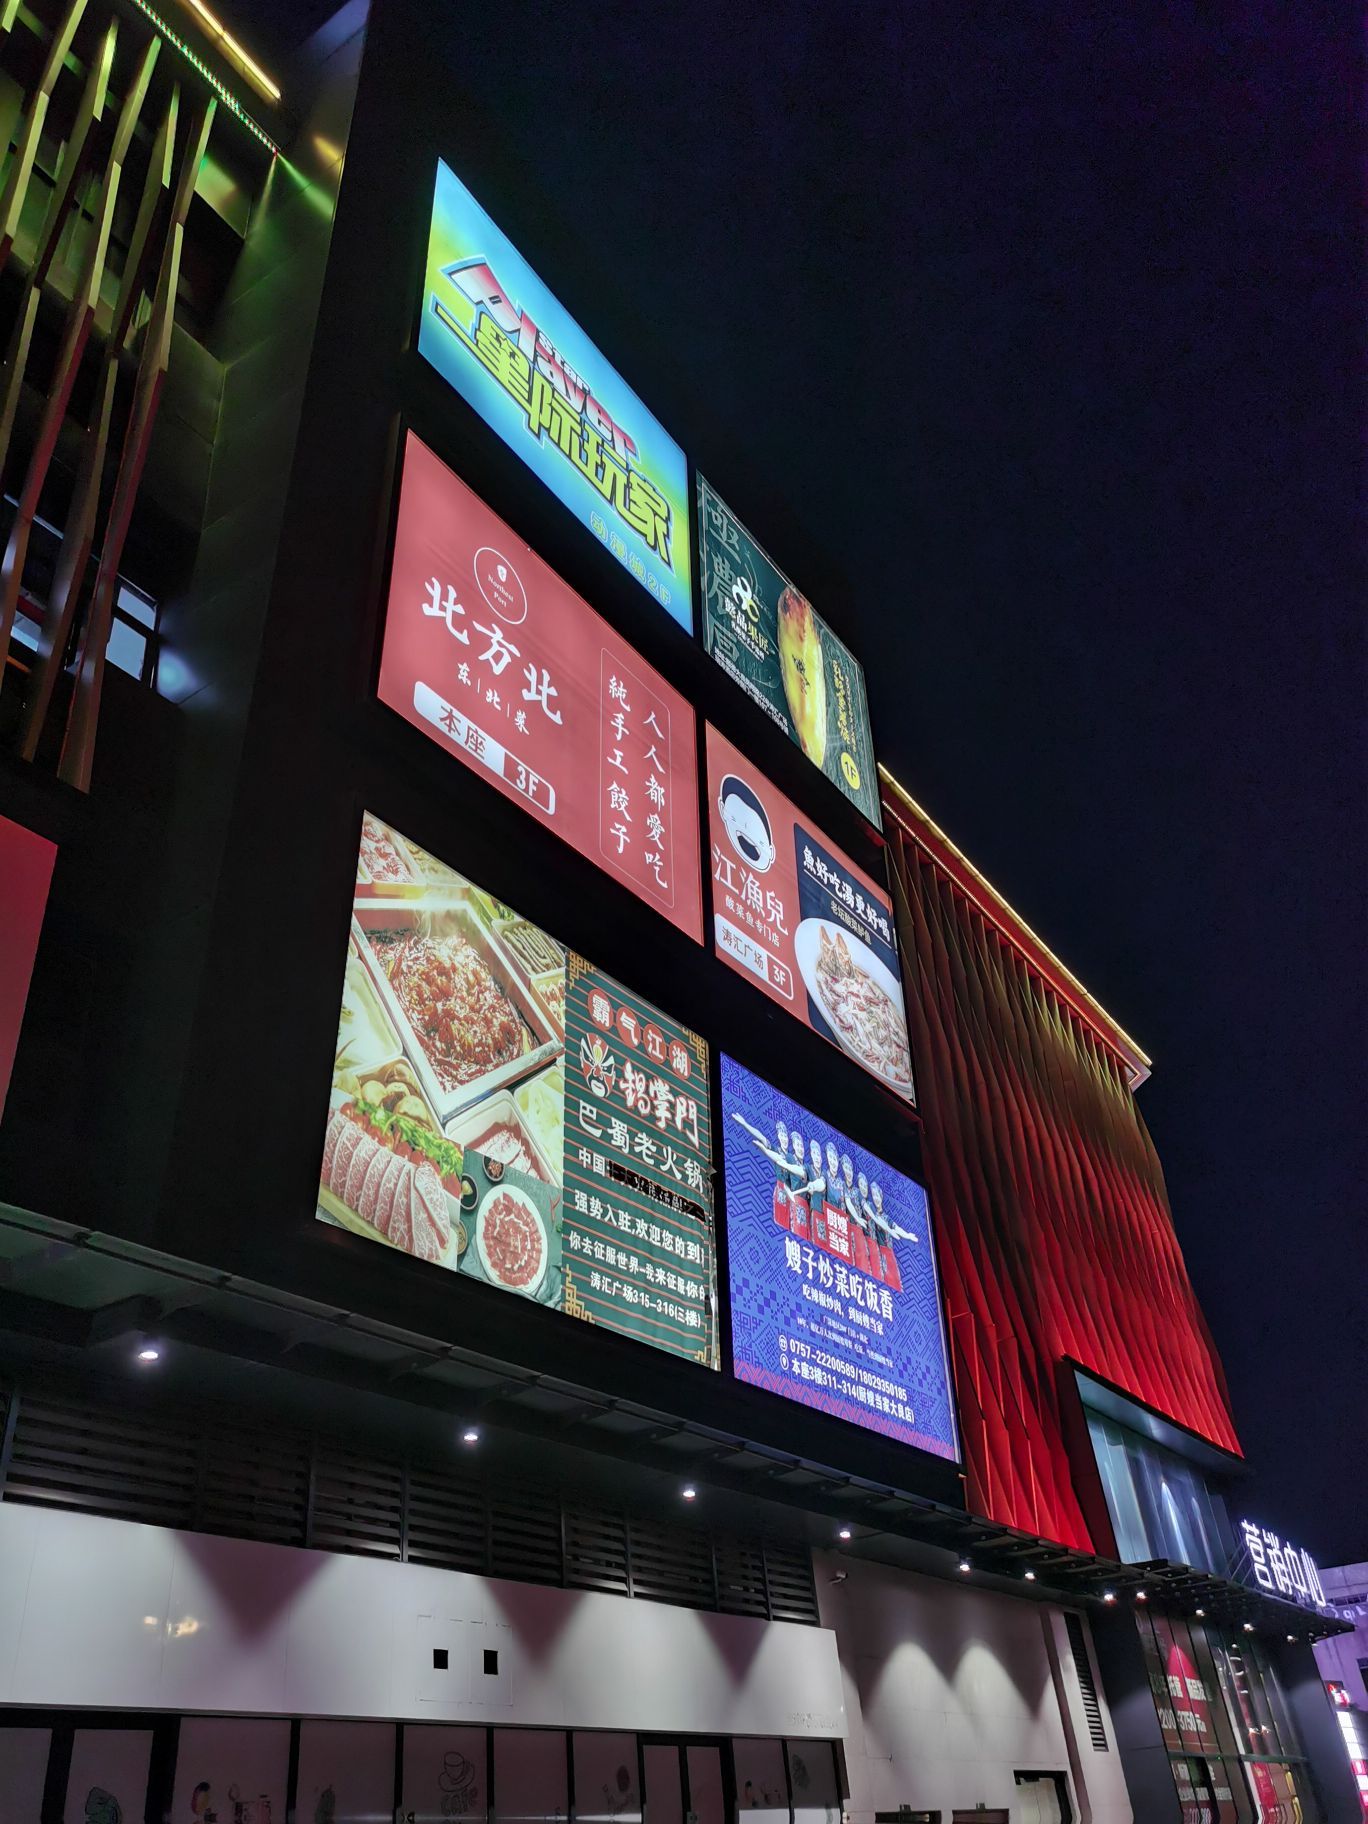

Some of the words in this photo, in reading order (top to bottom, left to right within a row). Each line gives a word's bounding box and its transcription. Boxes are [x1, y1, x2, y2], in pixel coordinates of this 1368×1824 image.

[539, 332, 588, 399] Star
[436, 302, 670, 565] 星际玩家
[421, 577, 563, 726] 北方北
[439, 704, 486, 758] 本座
[515, 764, 538, 799] 3F
[846, 764, 857, 784] 1F
[712, 847, 788, 936] 江漁兒
[772, 966, 787, 988] 3F
[593, 992, 688, 1077] 霸气江湖
[579, 1098, 703, 1194] 巴蜀老火锅
[574, 1189, 705, 1268] 强势入驻,欢迎您的到
[826, 1207, 848, 1236] 厨嫂
[827, 1229, 850, 1258] 当家
[786, 1236, 894, 1322] 嫂子炒菜吃饭香
